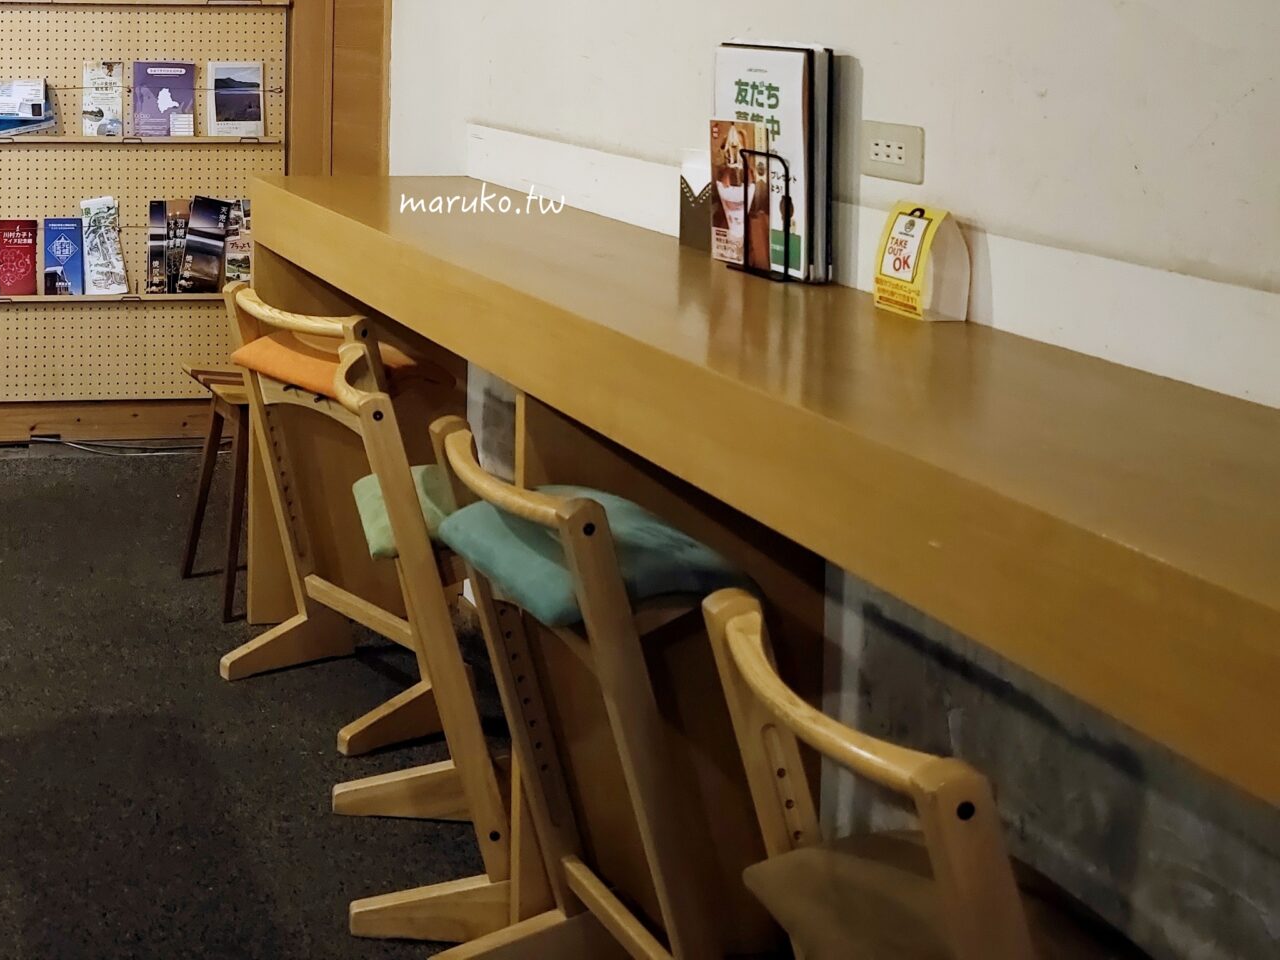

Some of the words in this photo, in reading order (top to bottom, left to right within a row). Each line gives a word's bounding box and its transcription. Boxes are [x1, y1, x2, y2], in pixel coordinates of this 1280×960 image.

[734, 78, 780, 109] 友だち
[890, 236, 908, 249] TAKE
[887, 246, 903, 256] OUT
[892, 255, 911, 272] OK
